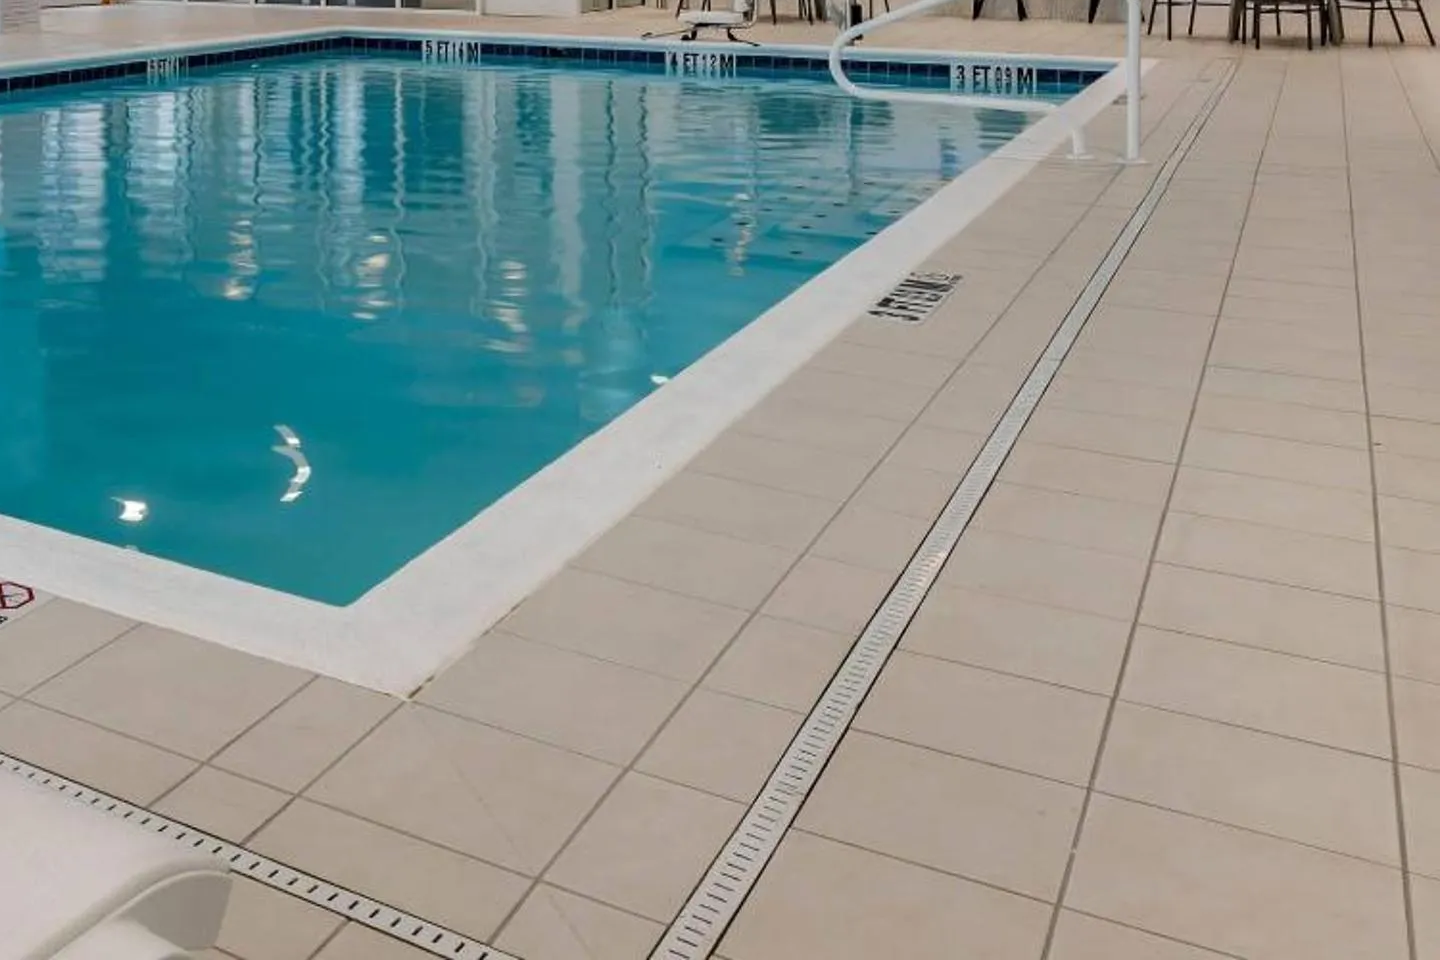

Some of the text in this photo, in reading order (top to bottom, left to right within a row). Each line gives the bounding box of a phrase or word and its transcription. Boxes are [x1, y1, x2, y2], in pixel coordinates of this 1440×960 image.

[437, 41, 449, 55] FT
[683, 53, 699, 66] FT
[720, 53, 734, 68] M
[956, 65, 965, 80] 3
[972, 65, 991, 81] FT
[1017, 67, 1034, 82] M
